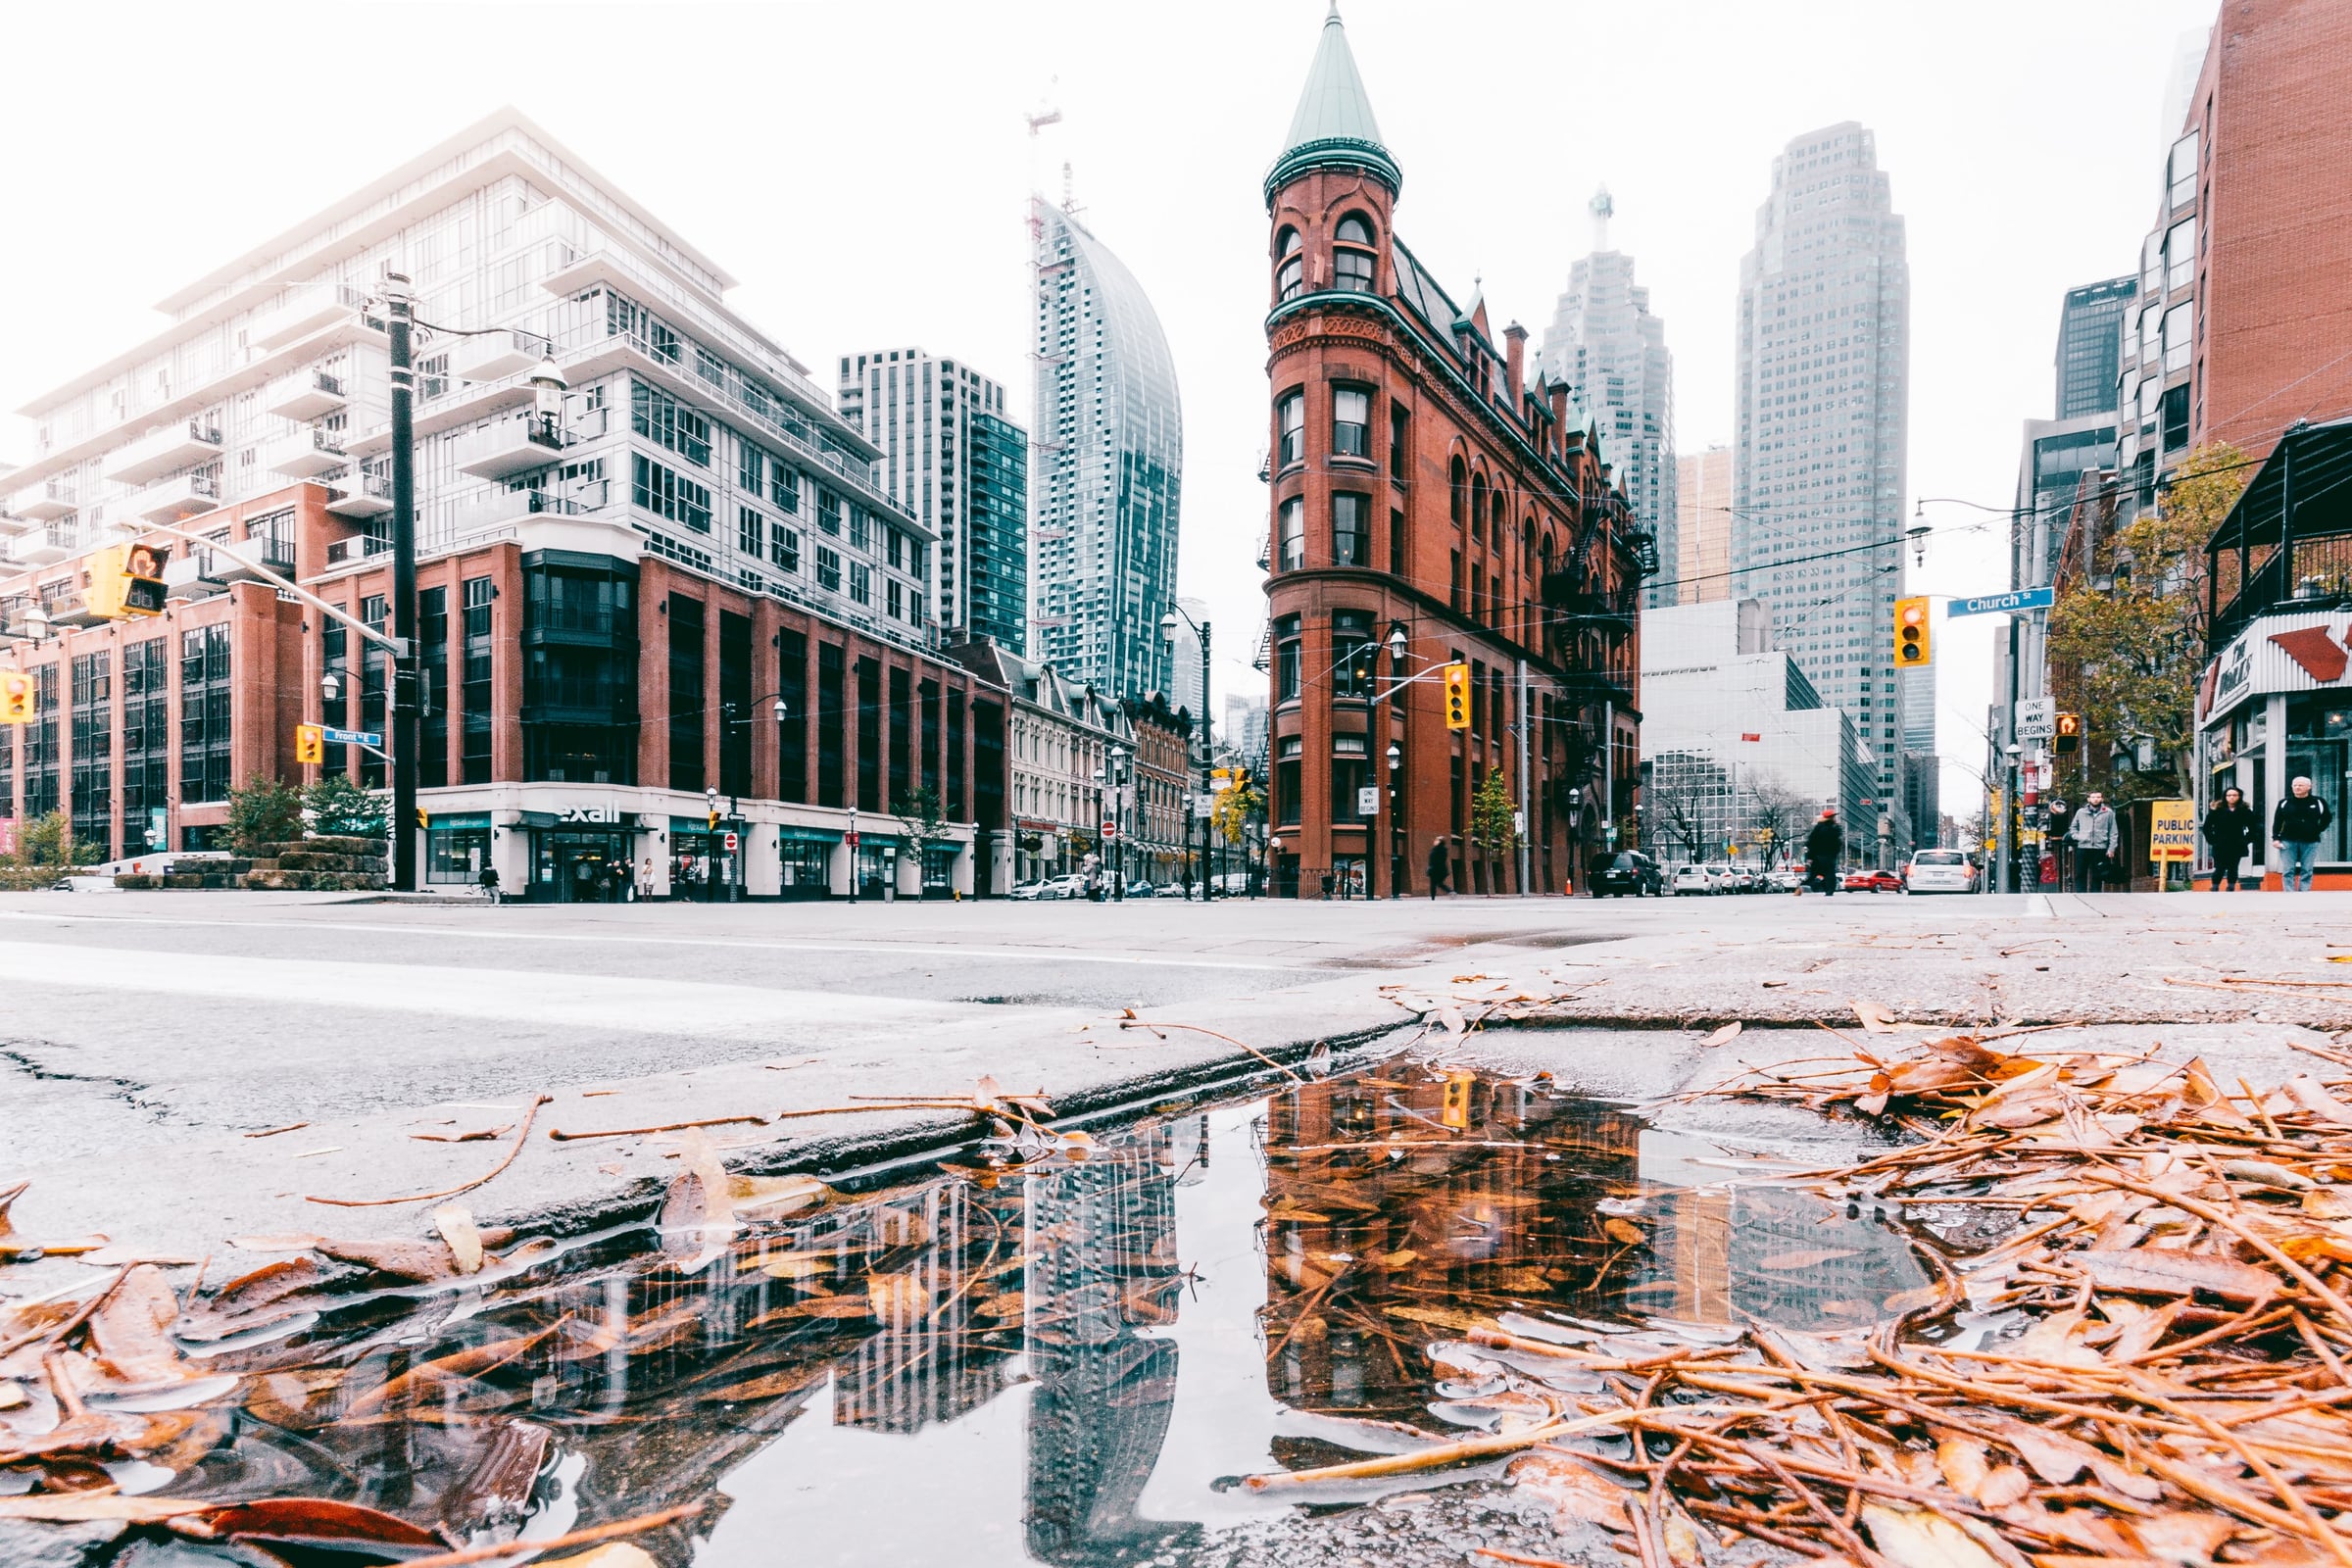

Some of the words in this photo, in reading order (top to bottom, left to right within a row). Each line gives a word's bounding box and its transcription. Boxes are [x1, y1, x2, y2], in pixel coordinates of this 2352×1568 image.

[1967, 594, 2020, 612] Church
[2025, 701, 2044, 711] ONE
[2025, 713, 2044, 722] WAY
[2017, 724, 2053, 736] BEGINS
[334, 731, 358, 741] Front
[364, 733, 369, 742] E
[2157, 819, 2194, 831] PUBLIC
